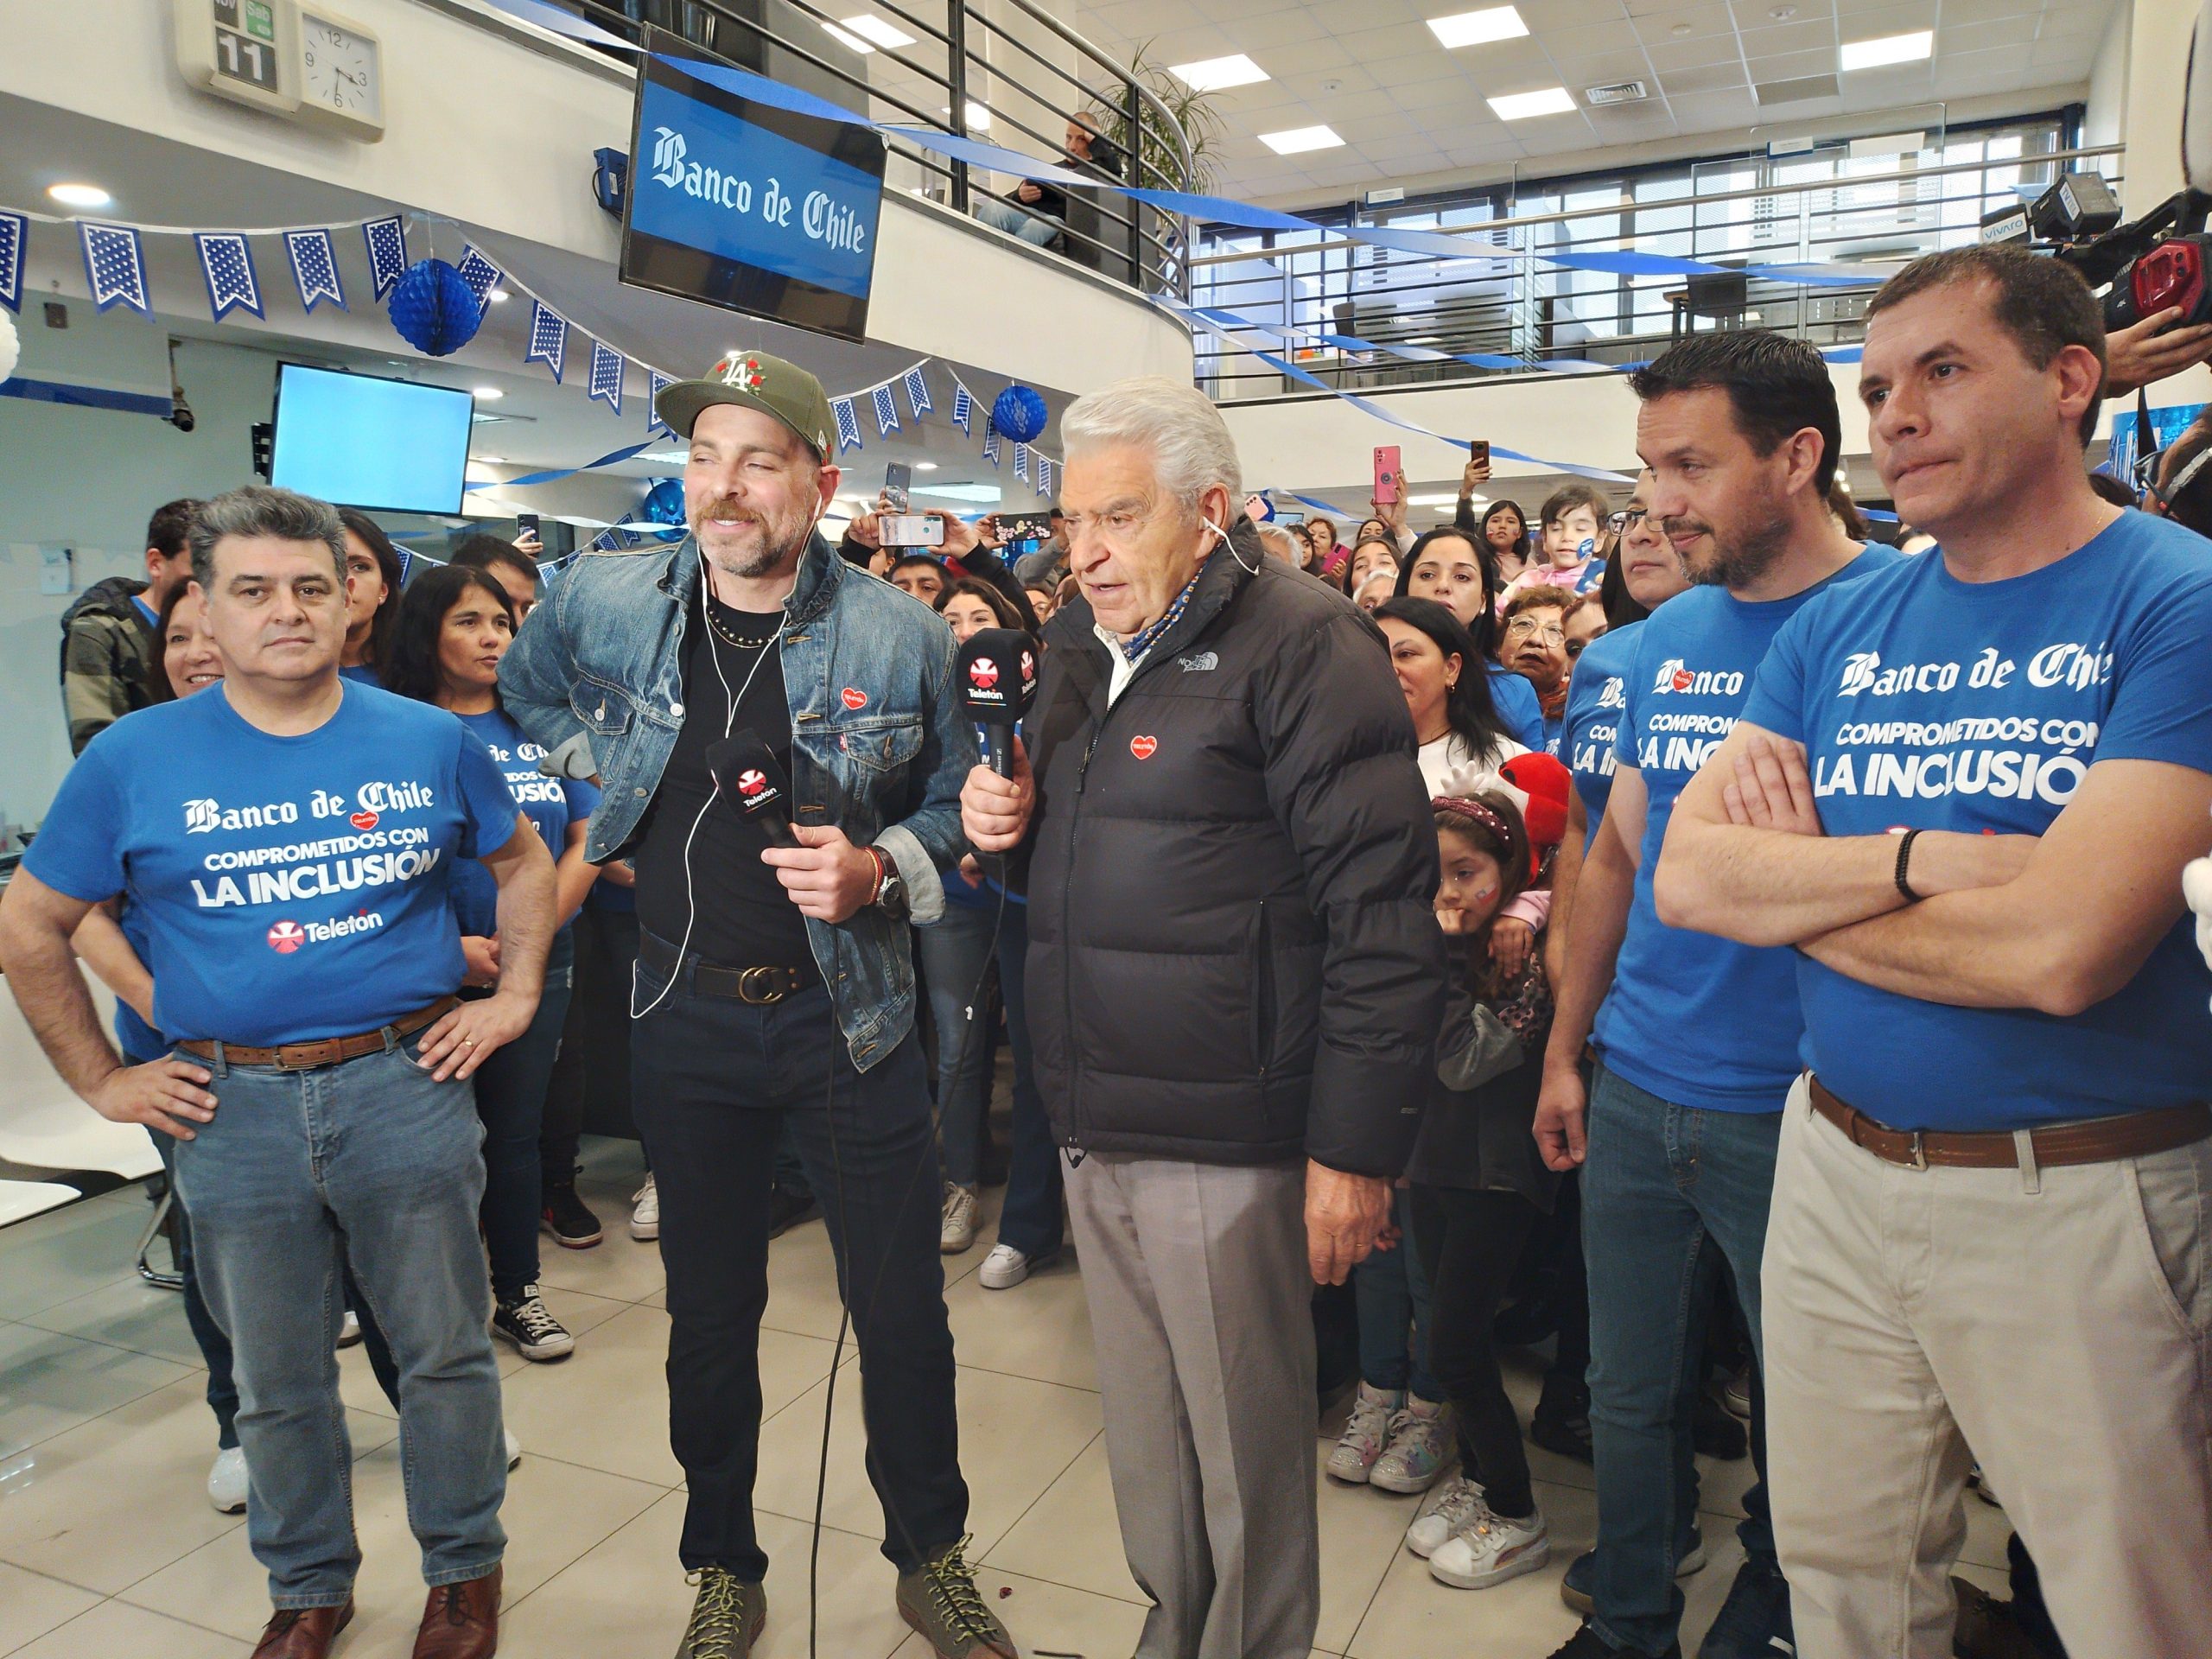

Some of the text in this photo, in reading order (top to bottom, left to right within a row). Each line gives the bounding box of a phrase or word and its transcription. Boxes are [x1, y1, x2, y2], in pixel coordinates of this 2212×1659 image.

[327, 31, 342, 47] 12
[219, 35, 263, 80] 11
[305, 53, 315, 67] 9
[359, 72, 367, 86] 3
[334, 93, 343, 108] 6
[652, 127, 865, 253] Banco de Chile
[721, 357, 752, 392] LA
[1837, 651, 1961, 697] Banco
[1967, 646, 2016, 690] de
[1836, 716, 2039, 747] COMPROMETIDOS
[1573, 741, 1597, 773] LA
[1638, 736, 1659, 769] LA
[1815, 748, 2089, 806] LA INCLUSIÓ
[181, 780, 435, 835] Banco de Chile
[204, 827, 429, 871] COMPROMETIDOS CON
[190, 844, 441, 907] LA INCLUSIÓN
